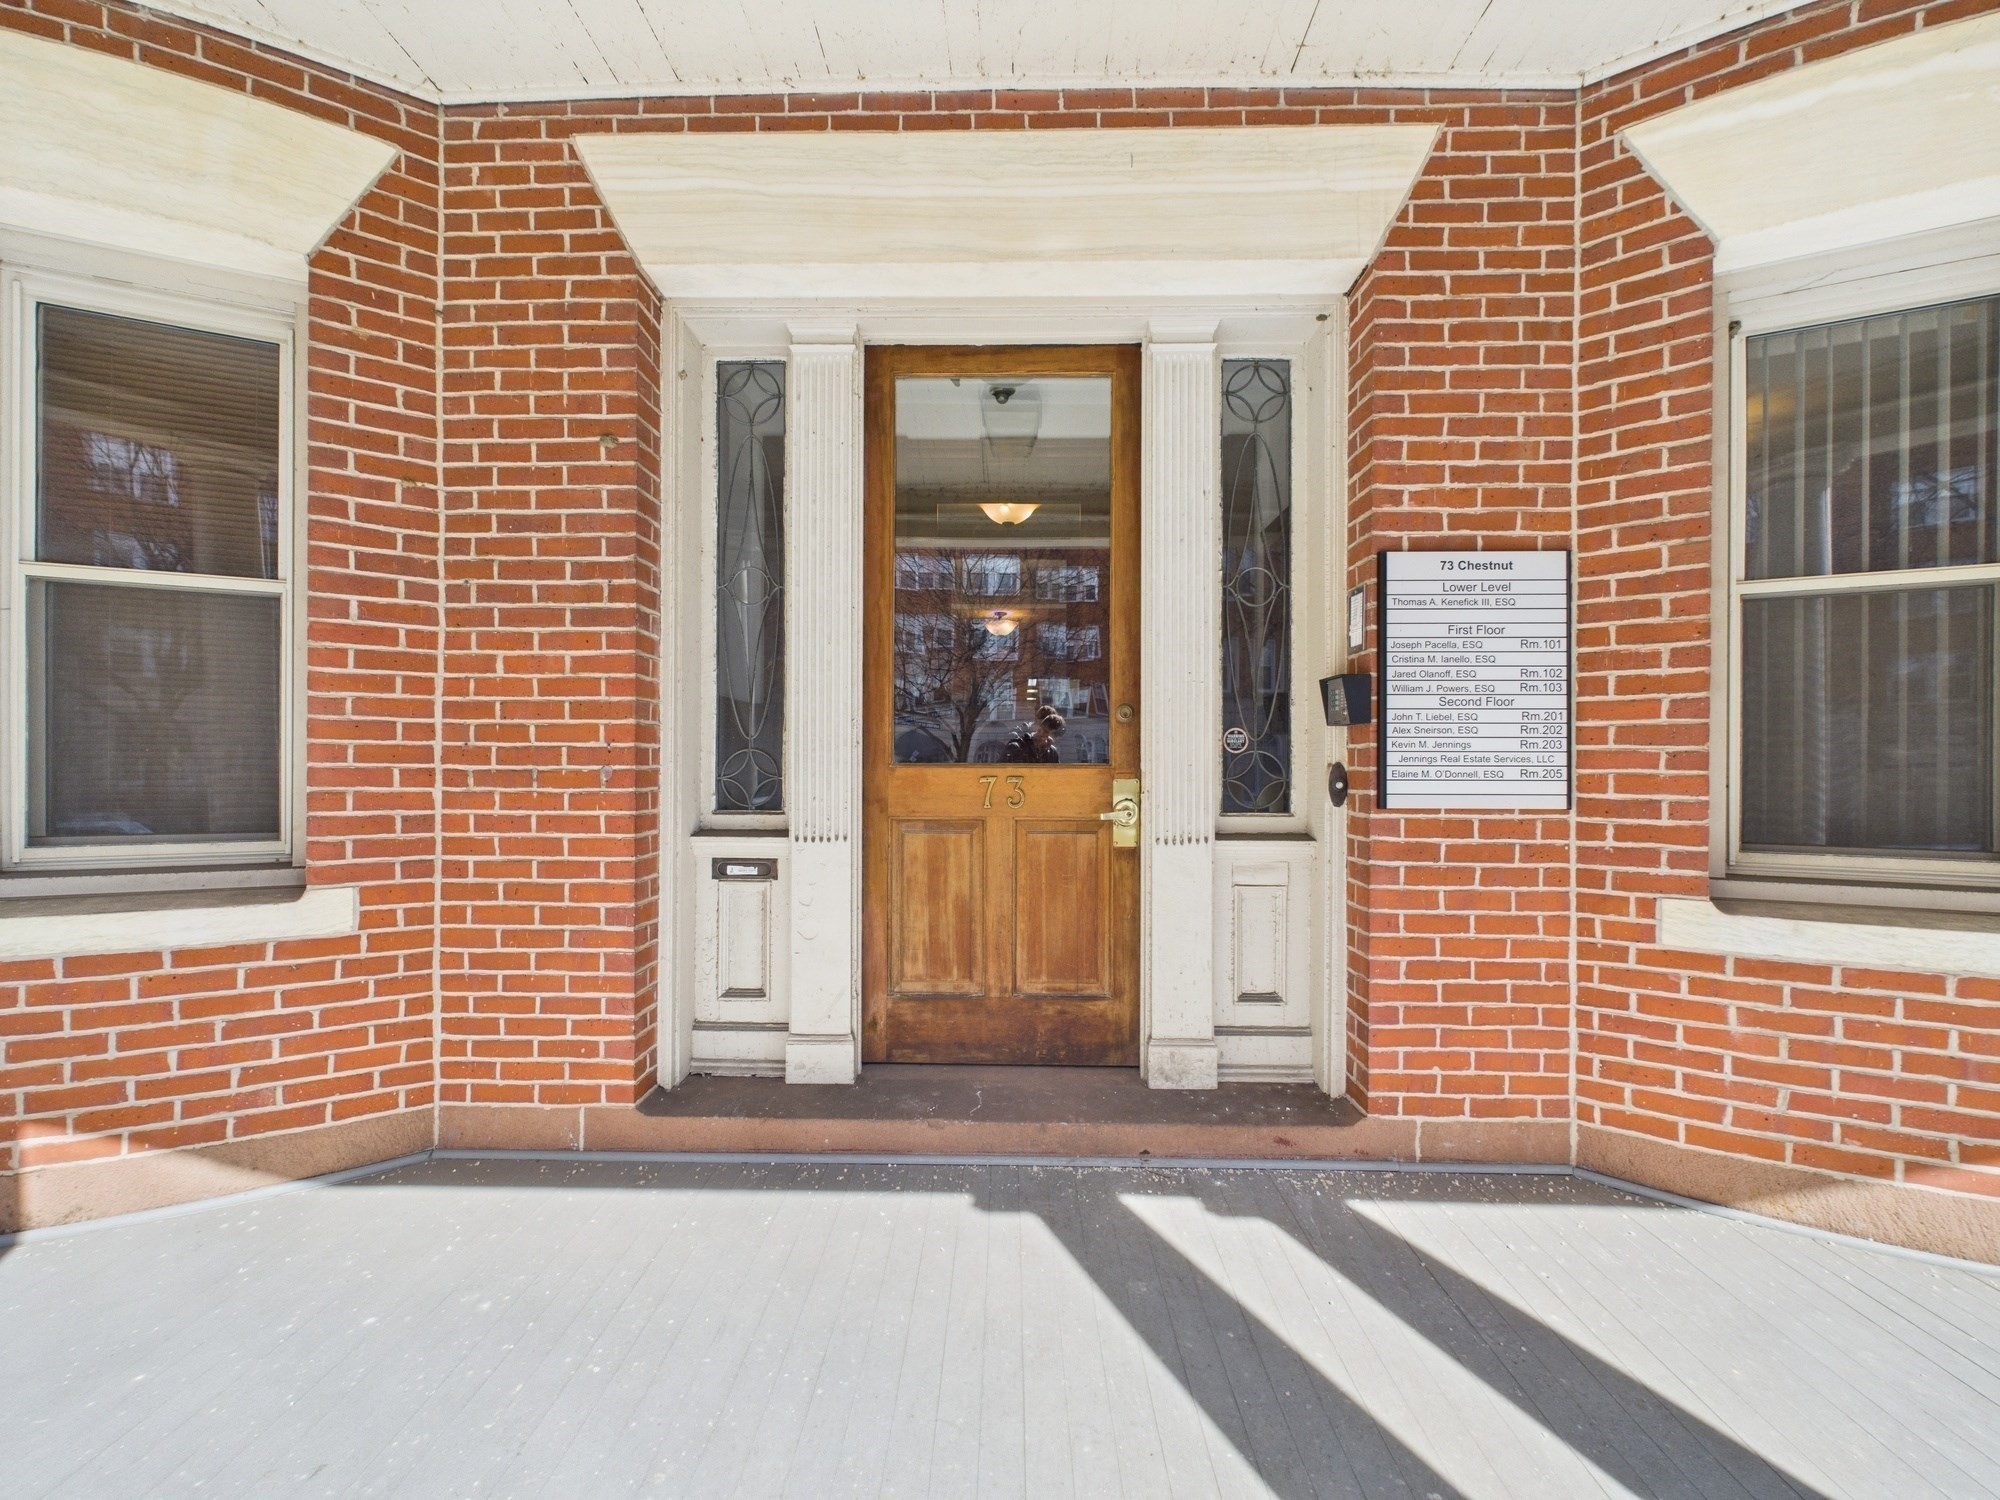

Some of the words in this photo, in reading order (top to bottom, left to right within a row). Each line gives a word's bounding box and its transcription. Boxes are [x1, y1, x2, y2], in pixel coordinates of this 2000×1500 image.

[1440, 560, 1455, 571] 73
[1458, 560, 1514, 571] Chestnut
[1442, 582, 1477, 593] Lower
[1480, 582, 1512, 592] Level
[1392, 598, 1427, 606] Thomas
[1429, 598, 1438, 606] A.
[1441, 598, 1479, 606] Kenefick
[1495, 598, 1516, 607] ESQ
[1447, 624, 1473, 635] First
[1476, 624, 1506, 635] Floor
[1390, 640, 1422, 651] Joseph
[1462, 641, 1483, 649] ESQ
[1520, 639, 1561, 649] Rm.101
[1391, 655, 1425, 664] Cristina
[1427, 655, 1438, 664] M.
[1475, 655, 1496, 664] ESQ
[1391, 669, 1417, 679] Jared
[1456, 670, 1477, 679] ESQ
[1520, 668, 1563, 678] Rm.102
[1391, 684, 1424, 693] William
[1426, 684, 1434, 693] J.
[1475, 684, 1496, 694] ESQ
[1519, 682, 1563, 693] Rm.103
[1438, 696, 1482, 707] Second
[1485, 696, 1515, 707] Floor
[1391, 712, 1413, 721] John
[1415, 713, 1423, 721] T.
[1457, 713, 1478, 722] ESQ
[1521, 711, 1563, 721] Rm.201
[1391, 726, 1411, 735] Alex
[1458, 726, 1479, 735] ESQ
[1520, 725, 1563, 735] Rm.202
[1391, 740, 1416, 749] Kevin
[1419, 740, 1429, 749] M.
[1432, 740, 1472, 751] Jennings
[1519, 739, 1563, 750] Rm.203
[1398, 754, 1438, 765] Jennings
[1440, 754, 1461, 763] Real
[1463, 755, 1491, 763] Estate
[1536, 755, 1555, 763] LLC
[1391, 770, 1418, 779] Elaine
[1421, 770, 1432, 778] M.
[1483, 770, 1504, 779] ESQ
[1519, 769, 1563, 779] Rm.205
[979, 775, 1026, 809] 73
